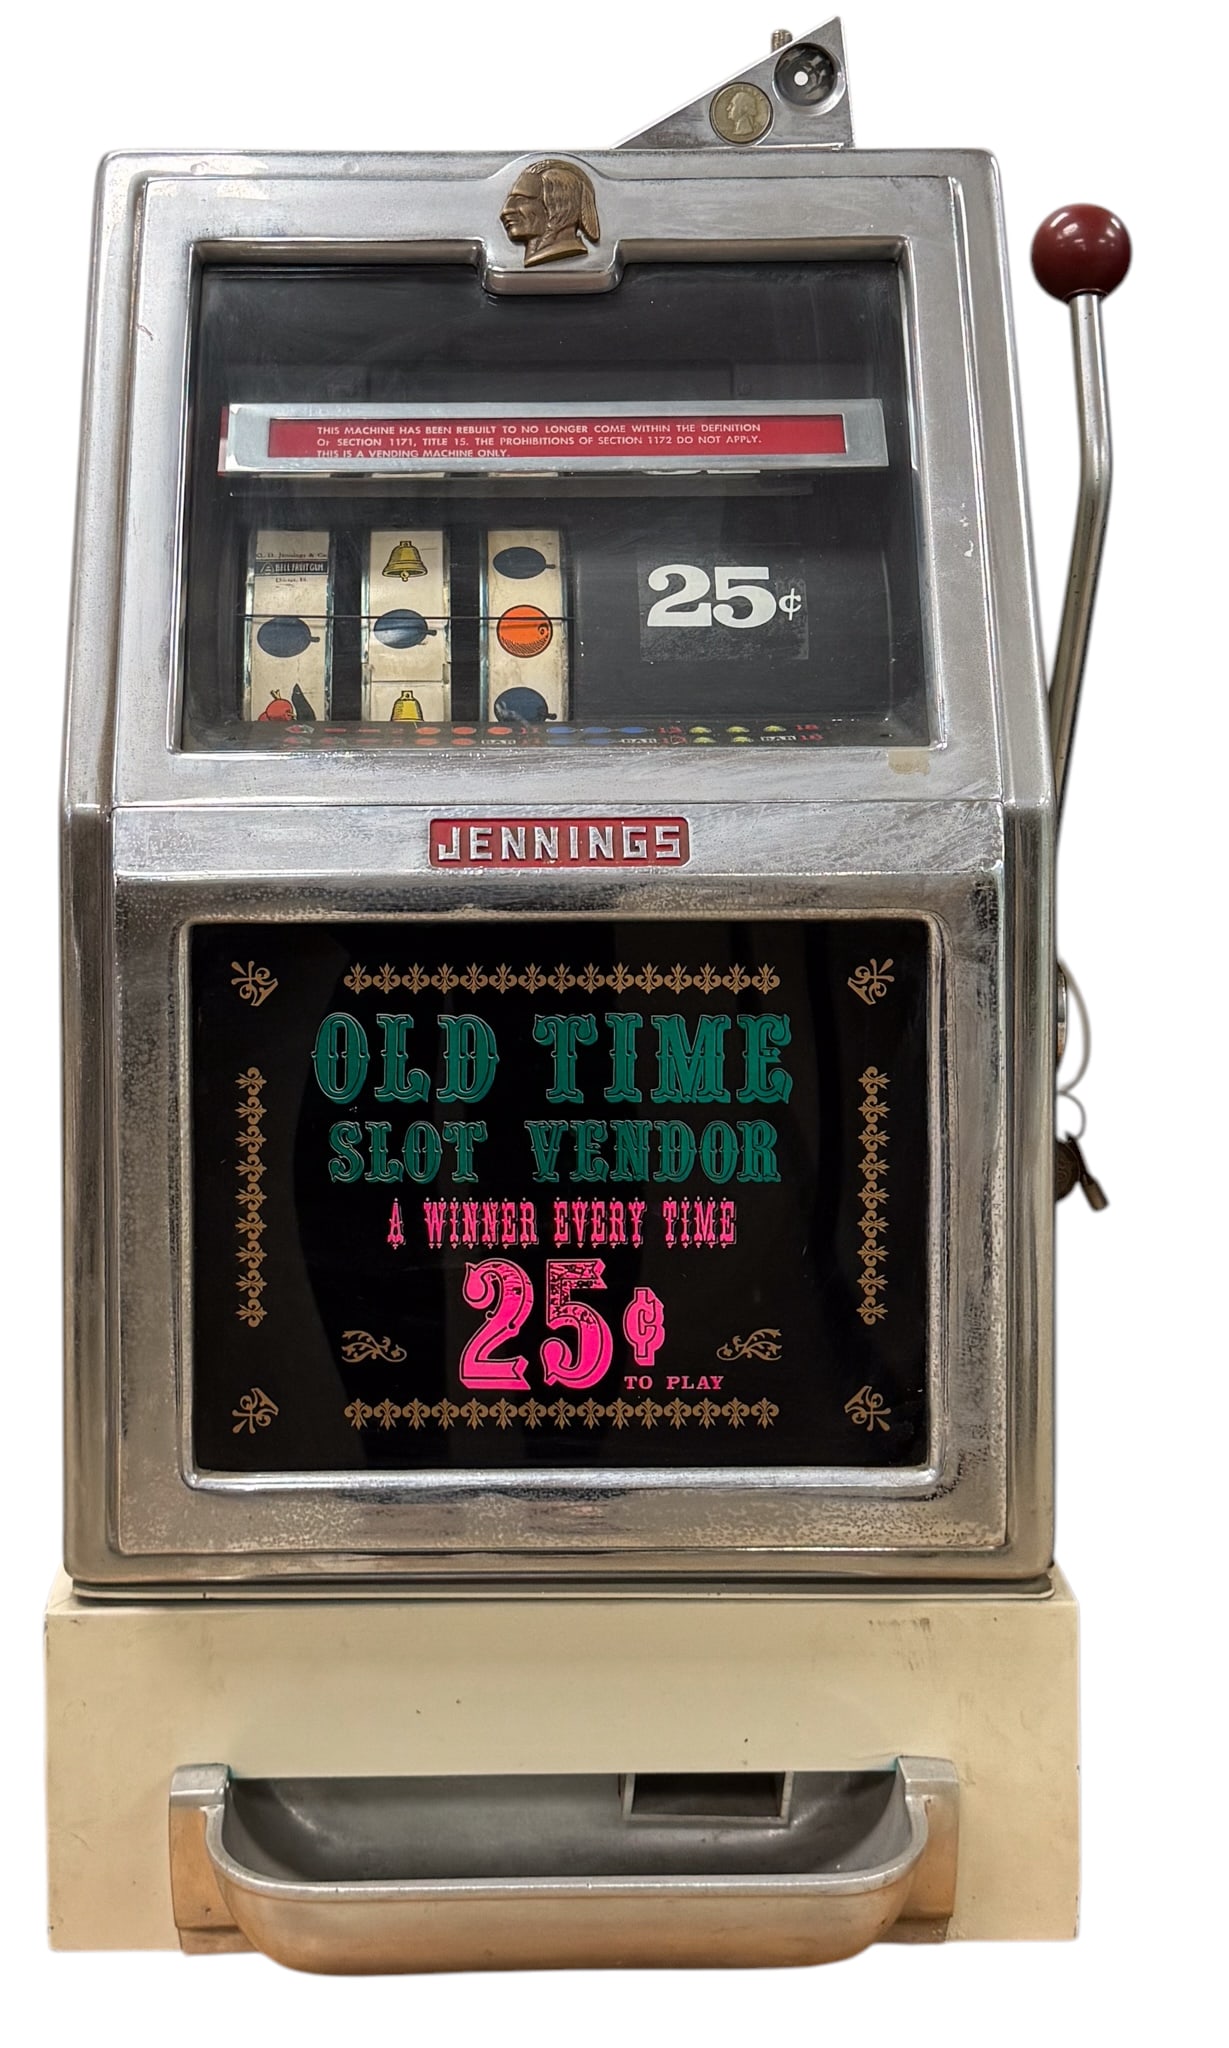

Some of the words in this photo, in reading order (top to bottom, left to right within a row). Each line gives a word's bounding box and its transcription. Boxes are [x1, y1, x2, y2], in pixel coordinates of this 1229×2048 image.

[317, 426, 340, 435] THIS
[344, 426, 395, 435] MACHINE
[399, 426, 421, 435] HAS
[425, 426, 452, 434] BEEN
[456, 425, 496, 434] REBUILT
[502, 425, 517, 434] TO
[521, 425, 539, 434] NO
[545, 425, 588, 434] LONGER
[593, 424, 626, 433] COME
[631, 424, 671, 433] WITHIN
[676, 424, 696, 432] THE
[701, 423, 761, 432] DEFINITION
[337, 438, 382, 446] SECTION
[389, 438, 417, 447] 1171,
[422, 438, 448, 446] TITLE
[455, 437, 469, 446] 15.
[474, 437, 494, 446] THE
[500, 437, 575, 446] PROHIBITIONS
[578, 436, 593, 445] OF
[598, 436, 643, 445] SECTION
[648, 436, 673, 445] 1172
[677, 436, 694, 444] DO
[698, 435, 721, 444] NOT
[726, 435, 762, 444] APPLY.
[317, 450, 339, 458] THIS
[343, 450, 352, 458] IS
[368, 450, 419, 458] VENDING
[422, 449, 473, 458] MACHINE
[647, 564, 802, 629] 25¢
[437, 825, 681, 861] JENNINGS
[311, 1012, 501, 1103] OLD
[532, 1012, 794, 1103] TIME
[328, 1120, 488, 1184] SLOT
[523, 1119, 783, 1184] VENDOR
[386, 1197, 406, 1250] A
[423, 1197, 540, 1250] WINNER
[554, 1197, 647, 1250] EVERY
[662, 1196, 737, 1250] TIME
[624, 1375, 654, 1390] TO
[666, 1375, 725, 1390] PLAY
